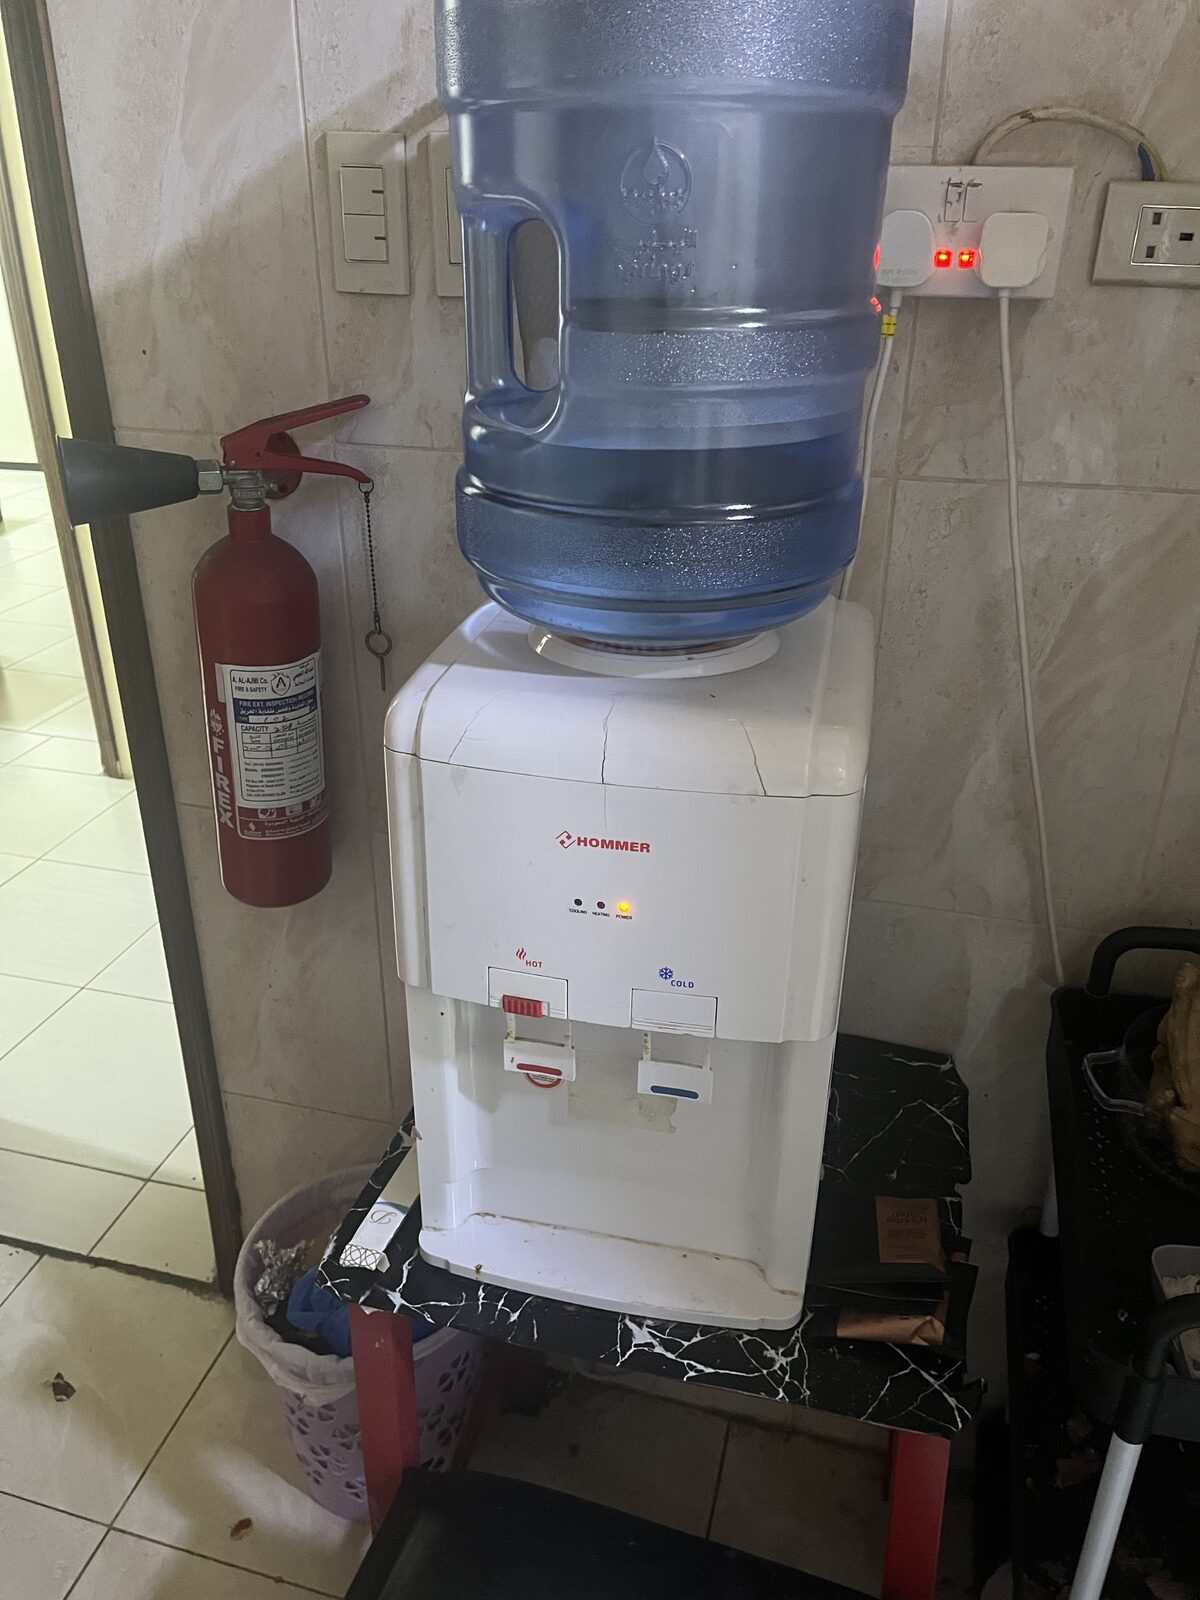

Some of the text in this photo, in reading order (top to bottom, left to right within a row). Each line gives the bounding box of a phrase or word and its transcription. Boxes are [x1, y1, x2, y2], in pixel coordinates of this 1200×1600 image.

[239, 700, 251, 708] FIRE
[265, 696, 298, 707] INSPECTION
[212, 735, 235, 829] FIREX
[576, 836, 651, 853] HOMMER
[525, 959, 543, 969] HOT
[670, 979, 695, 989] COLD
